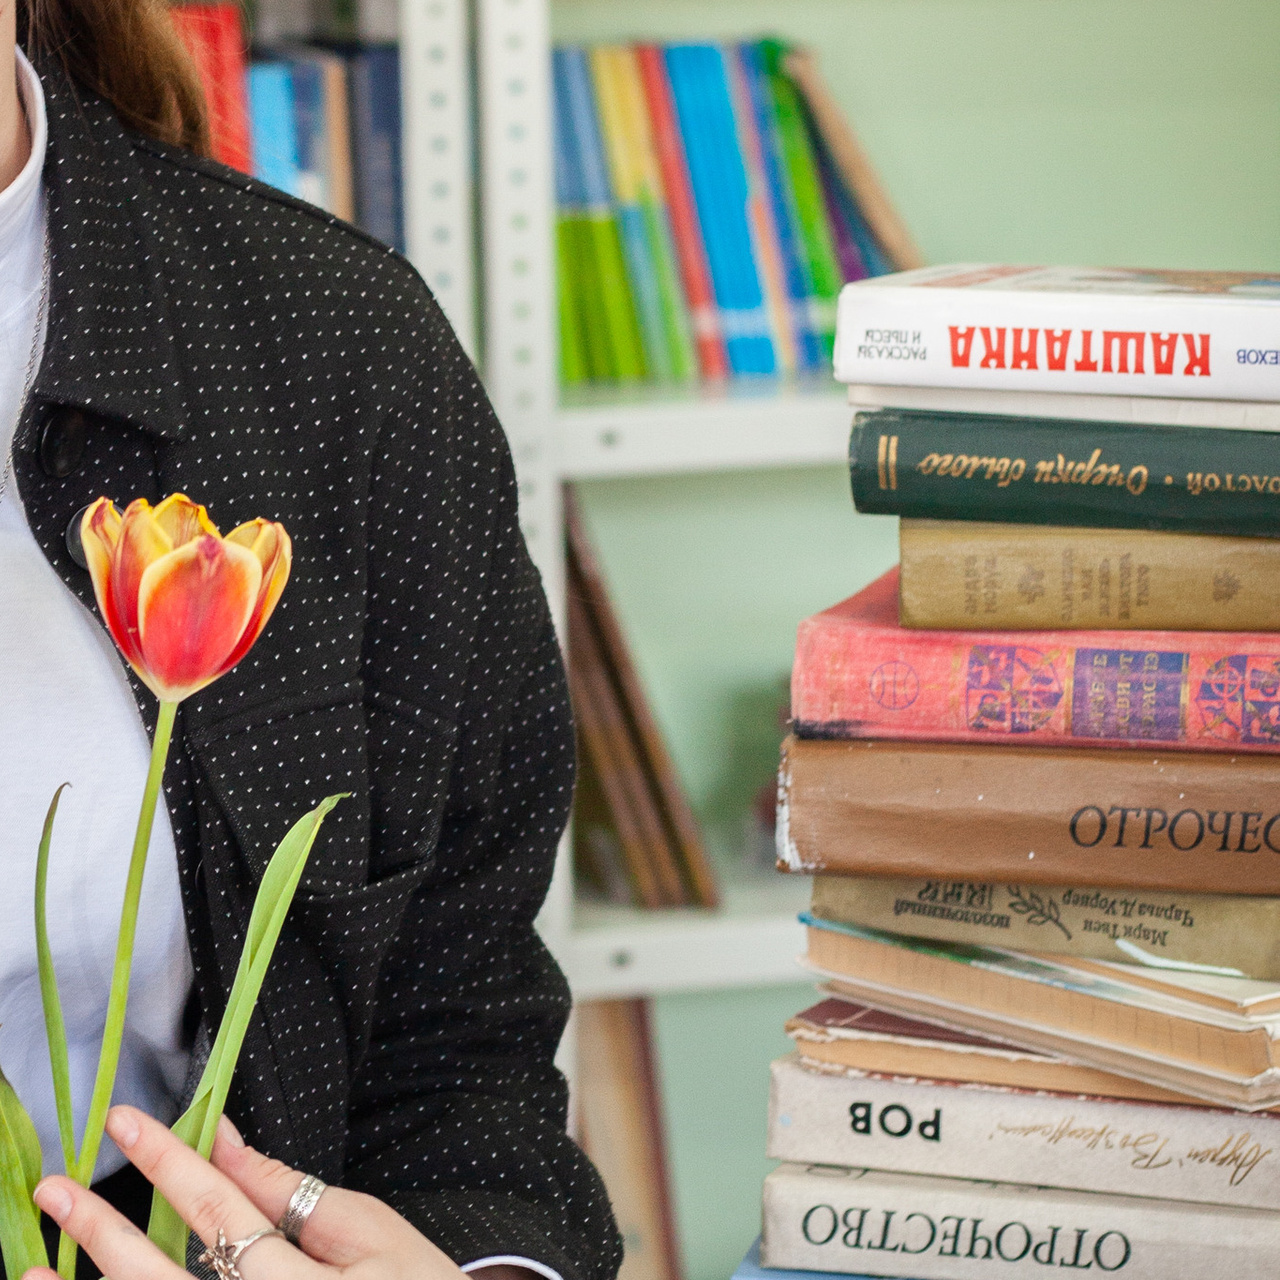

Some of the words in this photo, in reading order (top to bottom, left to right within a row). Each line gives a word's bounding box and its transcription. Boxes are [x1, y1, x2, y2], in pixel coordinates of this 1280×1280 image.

[864, 328, 911, 345] ПЬЕСЫ
[856, 344, 927, 362] РАССКАЗЫ
[948, 325, 1212, 377] КАШТАНКА
[1235, 348, 1280, 367] ЕХОВ
[1034, 448, 1149, 496] Очерки
[1081, 918, 1122, 940] Твен
[1123, 923, 1170, 947] Марк
[849, 1101, 942, 1143] РОВ
[801, 1204, 1133, 1273] ОТРОЧЕСТВО
